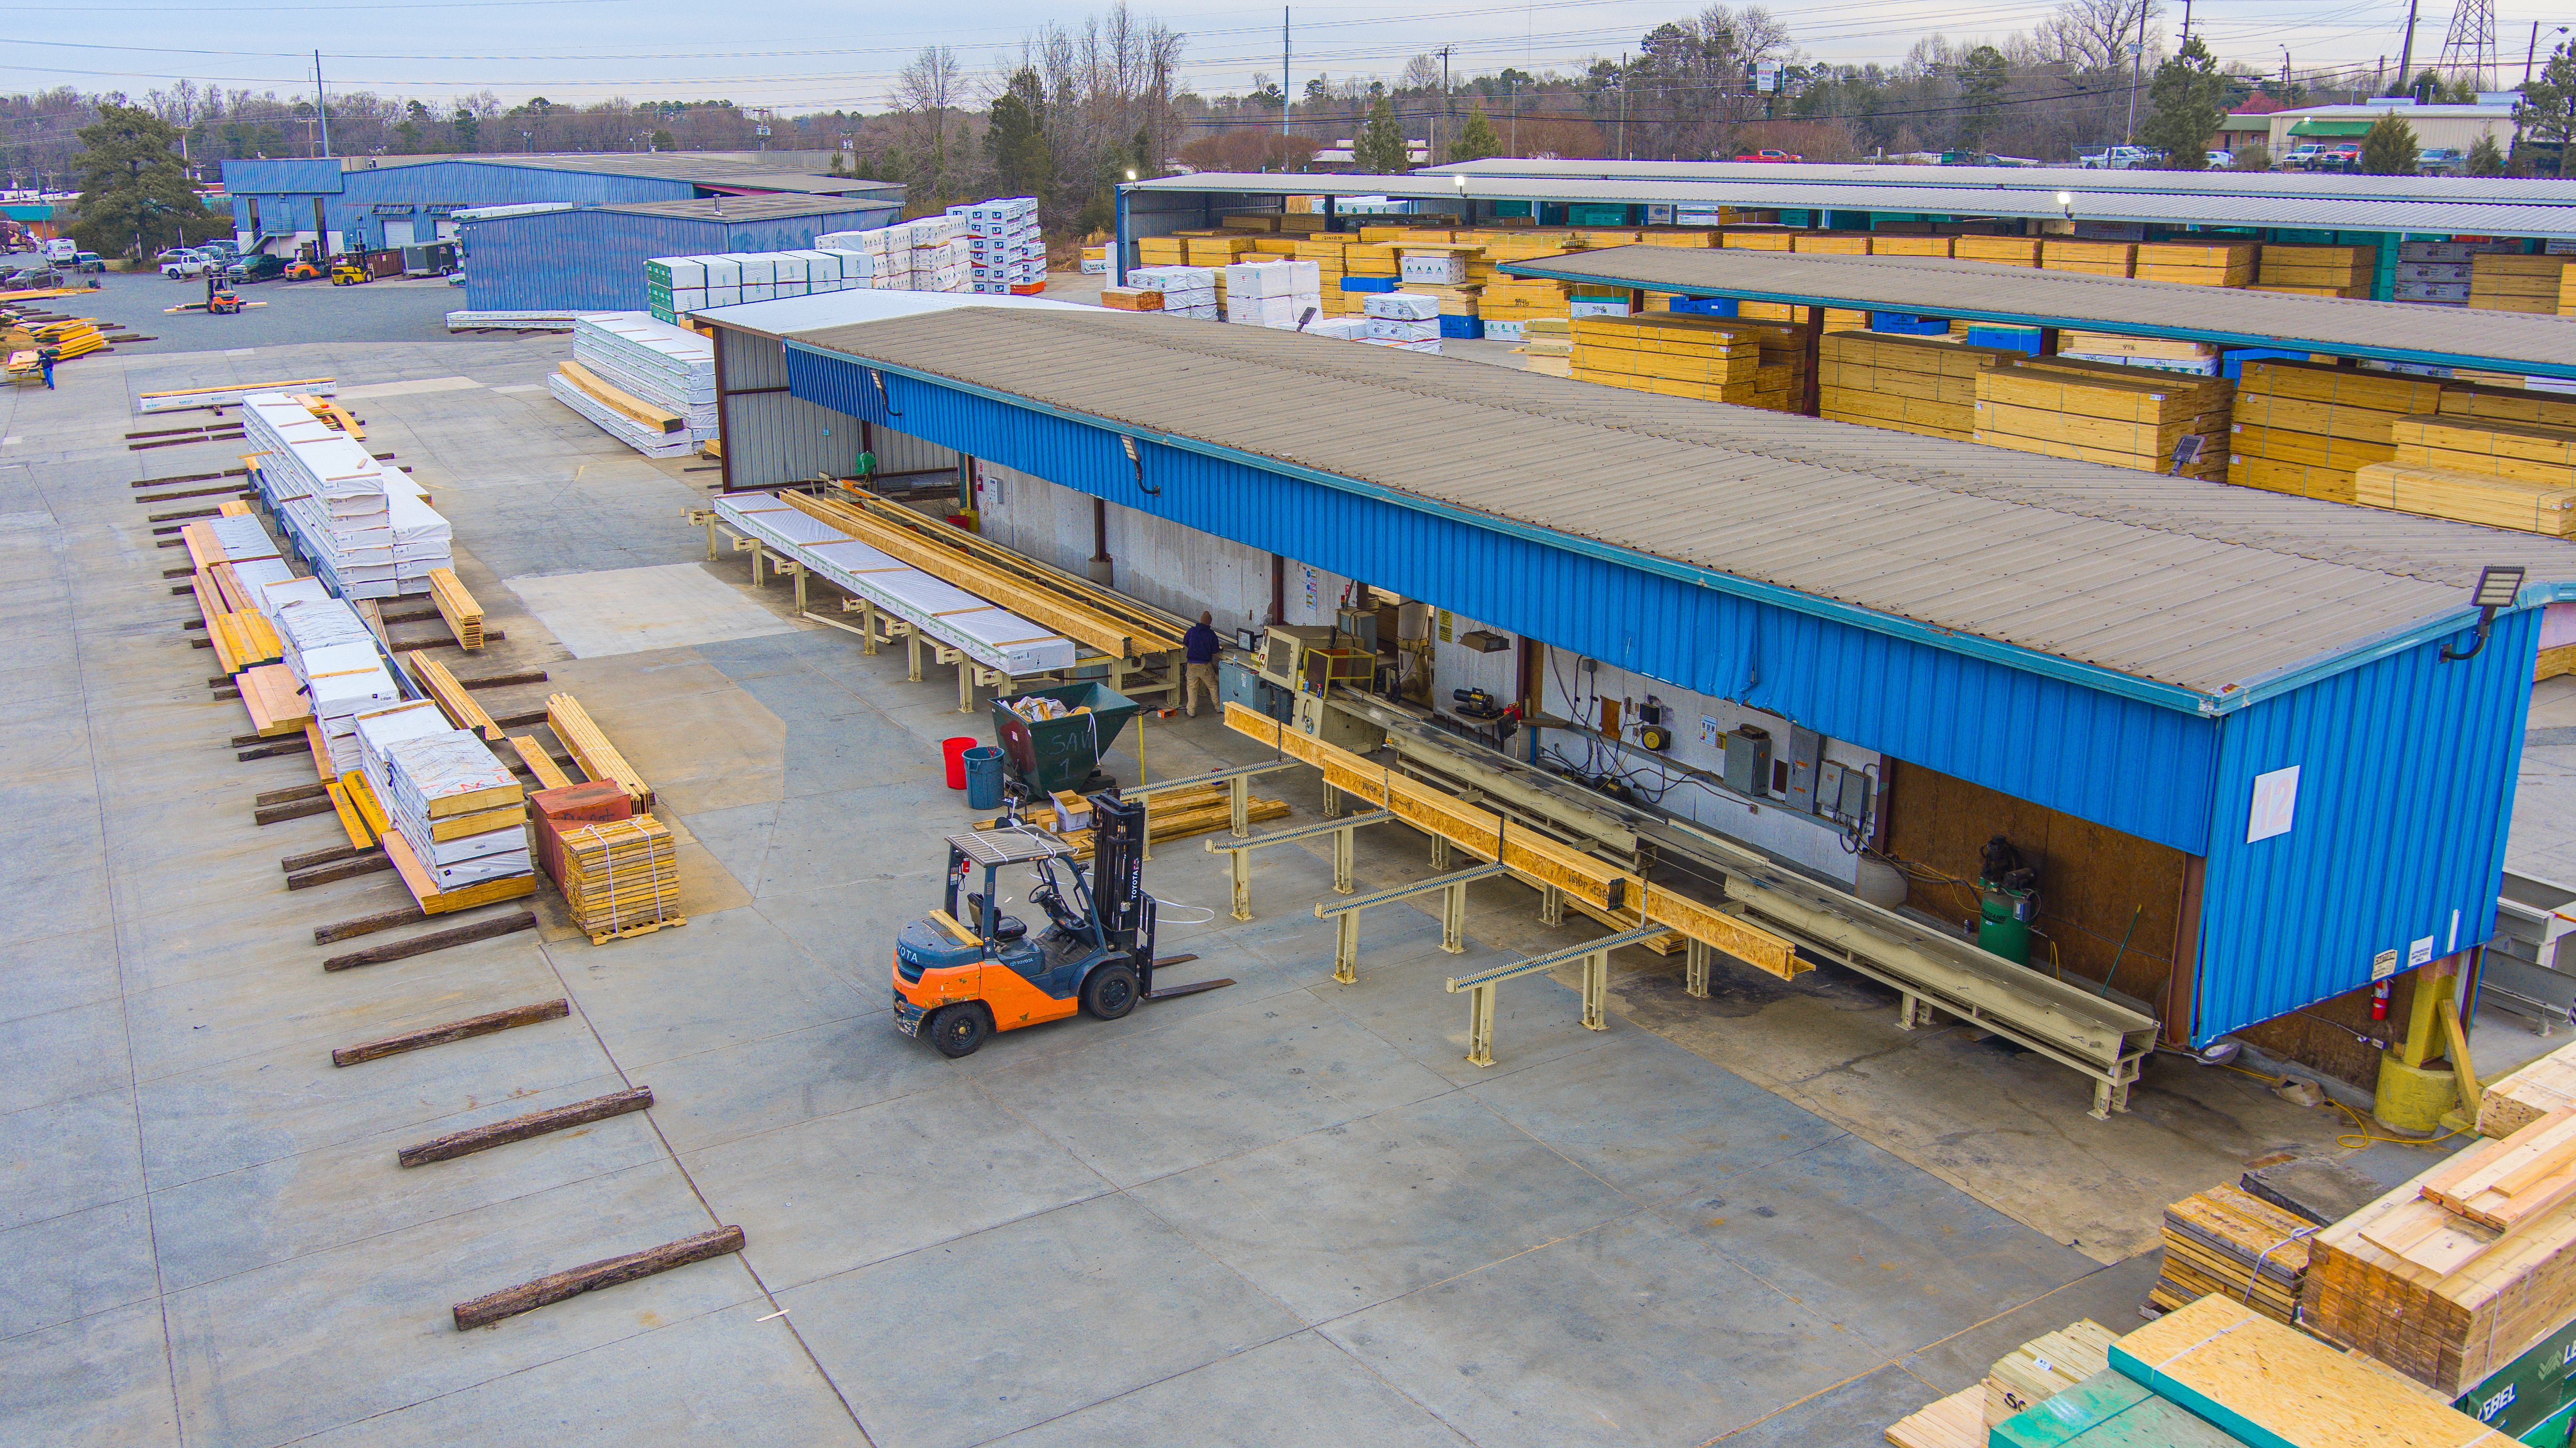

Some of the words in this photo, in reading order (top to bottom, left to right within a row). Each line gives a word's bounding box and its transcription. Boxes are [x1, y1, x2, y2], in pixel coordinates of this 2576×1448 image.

[1050, 731, 1094, 755] SAW
[2257, 778, 2293, 831] 12
[1131, 870, 1139, 900] TOYOTA
[896, 940, 918, 963] OYOTA
